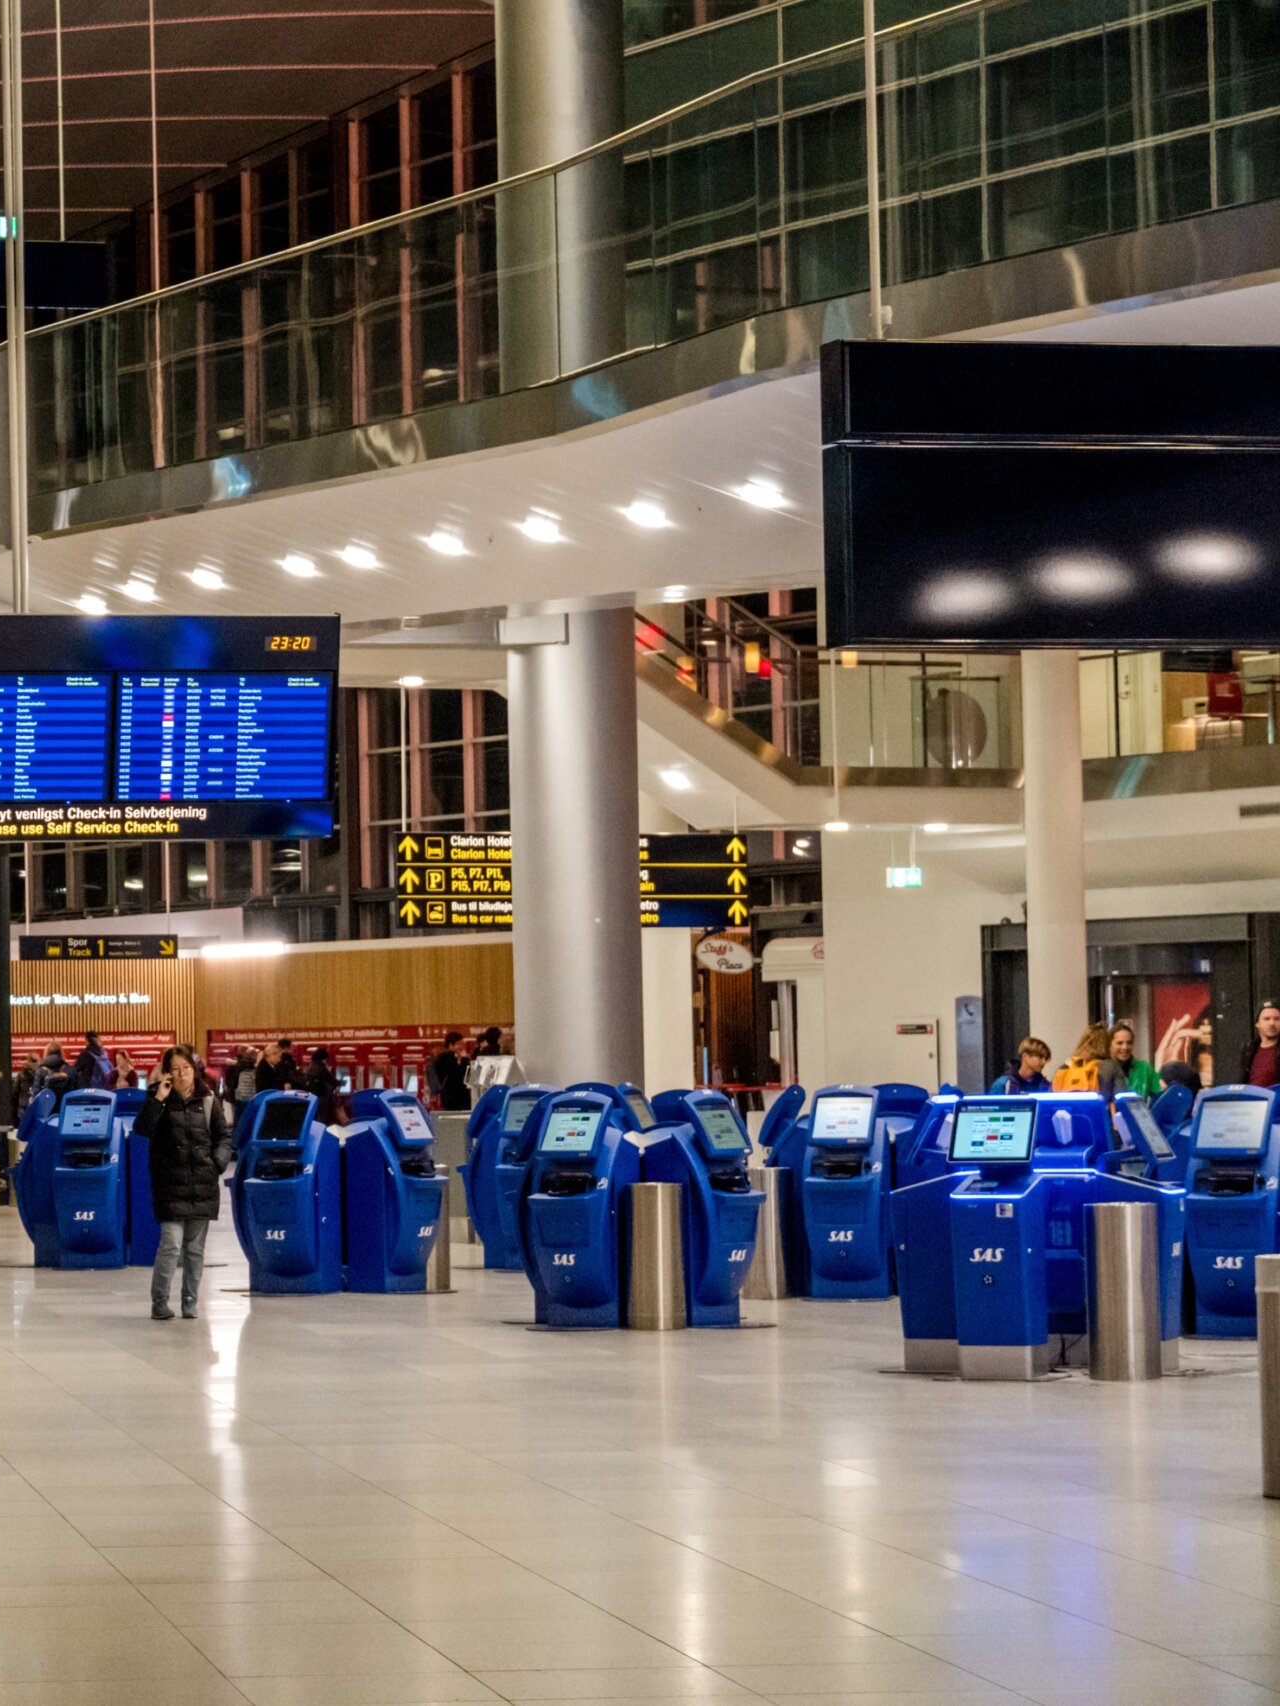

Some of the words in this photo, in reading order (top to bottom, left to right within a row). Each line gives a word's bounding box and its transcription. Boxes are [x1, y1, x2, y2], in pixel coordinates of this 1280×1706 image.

[270, 636, 312, 651] 23:20
[15, 807, 64, 823] venligst
[67, 806, 121, 819] Check-in
[125, 806, 206, 822] Selvbetjening
[21, 824, 44, 835] use
[47, 821, 72, 834] Self
[75, 821, 121, 834] Service
[124, 820, 179, 834] Check-in
[450, 835, 485, 847] Clarion
[487, 835, 512, 847] Hotel
[450, 848, 486, 860] Clarion
[487, 848, 512, 860] Hotel
[451, 867, 467, 880] P5,
[469, 867, 484, 880] P7,
[486, 867, 504, 880] P11,
[451, 880, 471, 893] P15,
[473, 880, 492, 893] P17,
[493, 880, 511, 893] P19
[451, 901, 467, 911] Bus
[468, 901, 478, 911] til
[479, 901, 513, 913] biludlejn
[640, 900, 660, 911] etro
[451, 914, 468, 924] Bus
[469, 915, 478, 924] to
[479, 915, 494, 924] car
[494, 914, 513, 924] renta
[640, 912, 660, 924] etro
[67, 938, 88, 947] Spor
[96, 939, 105, 957] 1
[68, 948, 92, 957] Track
[717, 957, 744, 970] Place
[9, 994, 33, 1005] kets
[34, 993, 52, 1005] for
[52, 993, 82, 1006] Train,
[83, 993, 117, 1004] Metro
[118, 992, 128, 1004] &
[129, 992, 150, 1004] Bus
[73, 1210, 95, 1221] SAS
[265, 1229, 286, 1241] SAS
[417, 1226, 434, 1238] SAS
[828, 1230, 854, 1243] SAS
[552, 1253, 576, 1266] SAS
[727, 1248, 747, 1262] SAS
[969, 1247, 1005, 1263] SAS
[1213, 1256, 1244, 1270] SAS
